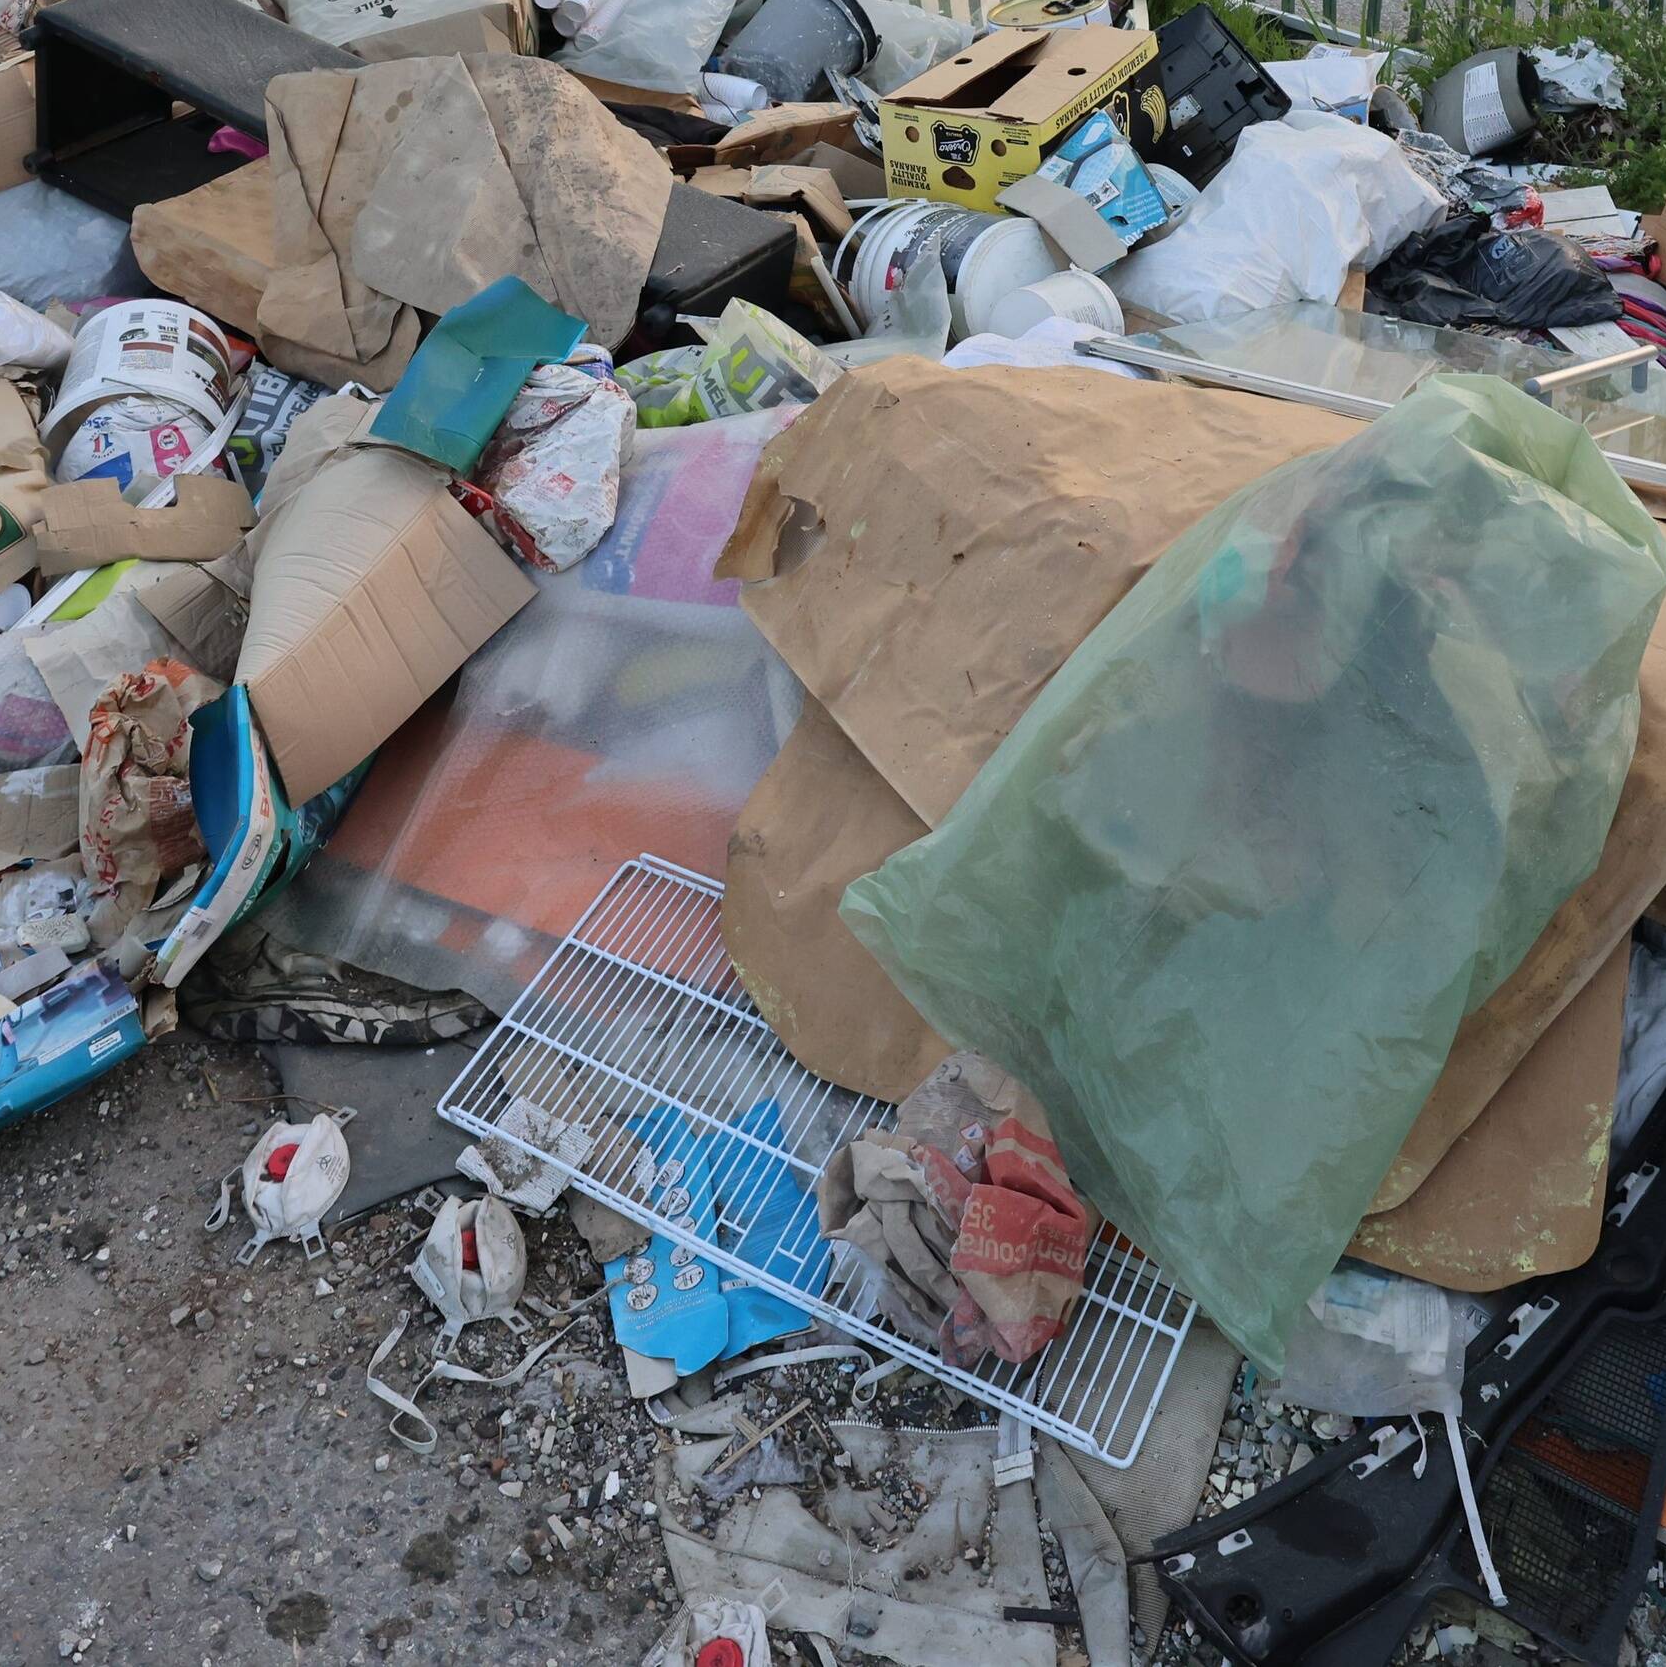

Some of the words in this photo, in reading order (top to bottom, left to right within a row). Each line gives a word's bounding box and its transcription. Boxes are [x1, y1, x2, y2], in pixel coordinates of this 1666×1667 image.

[1117, 48, 1148, 77] PREMIUM
[1087, 71, 1118, 102] QUALITY
[1054, 97, 1088, 130] BANANAS
[938, 138, 971, 152] Orsero
[889, 159, 927, 174] BANANAS
[891, 167, 927, 182] QUALITY
[891, 175, 931, 190] PREMIUM
[969, 1199, 996, 1231] 35
